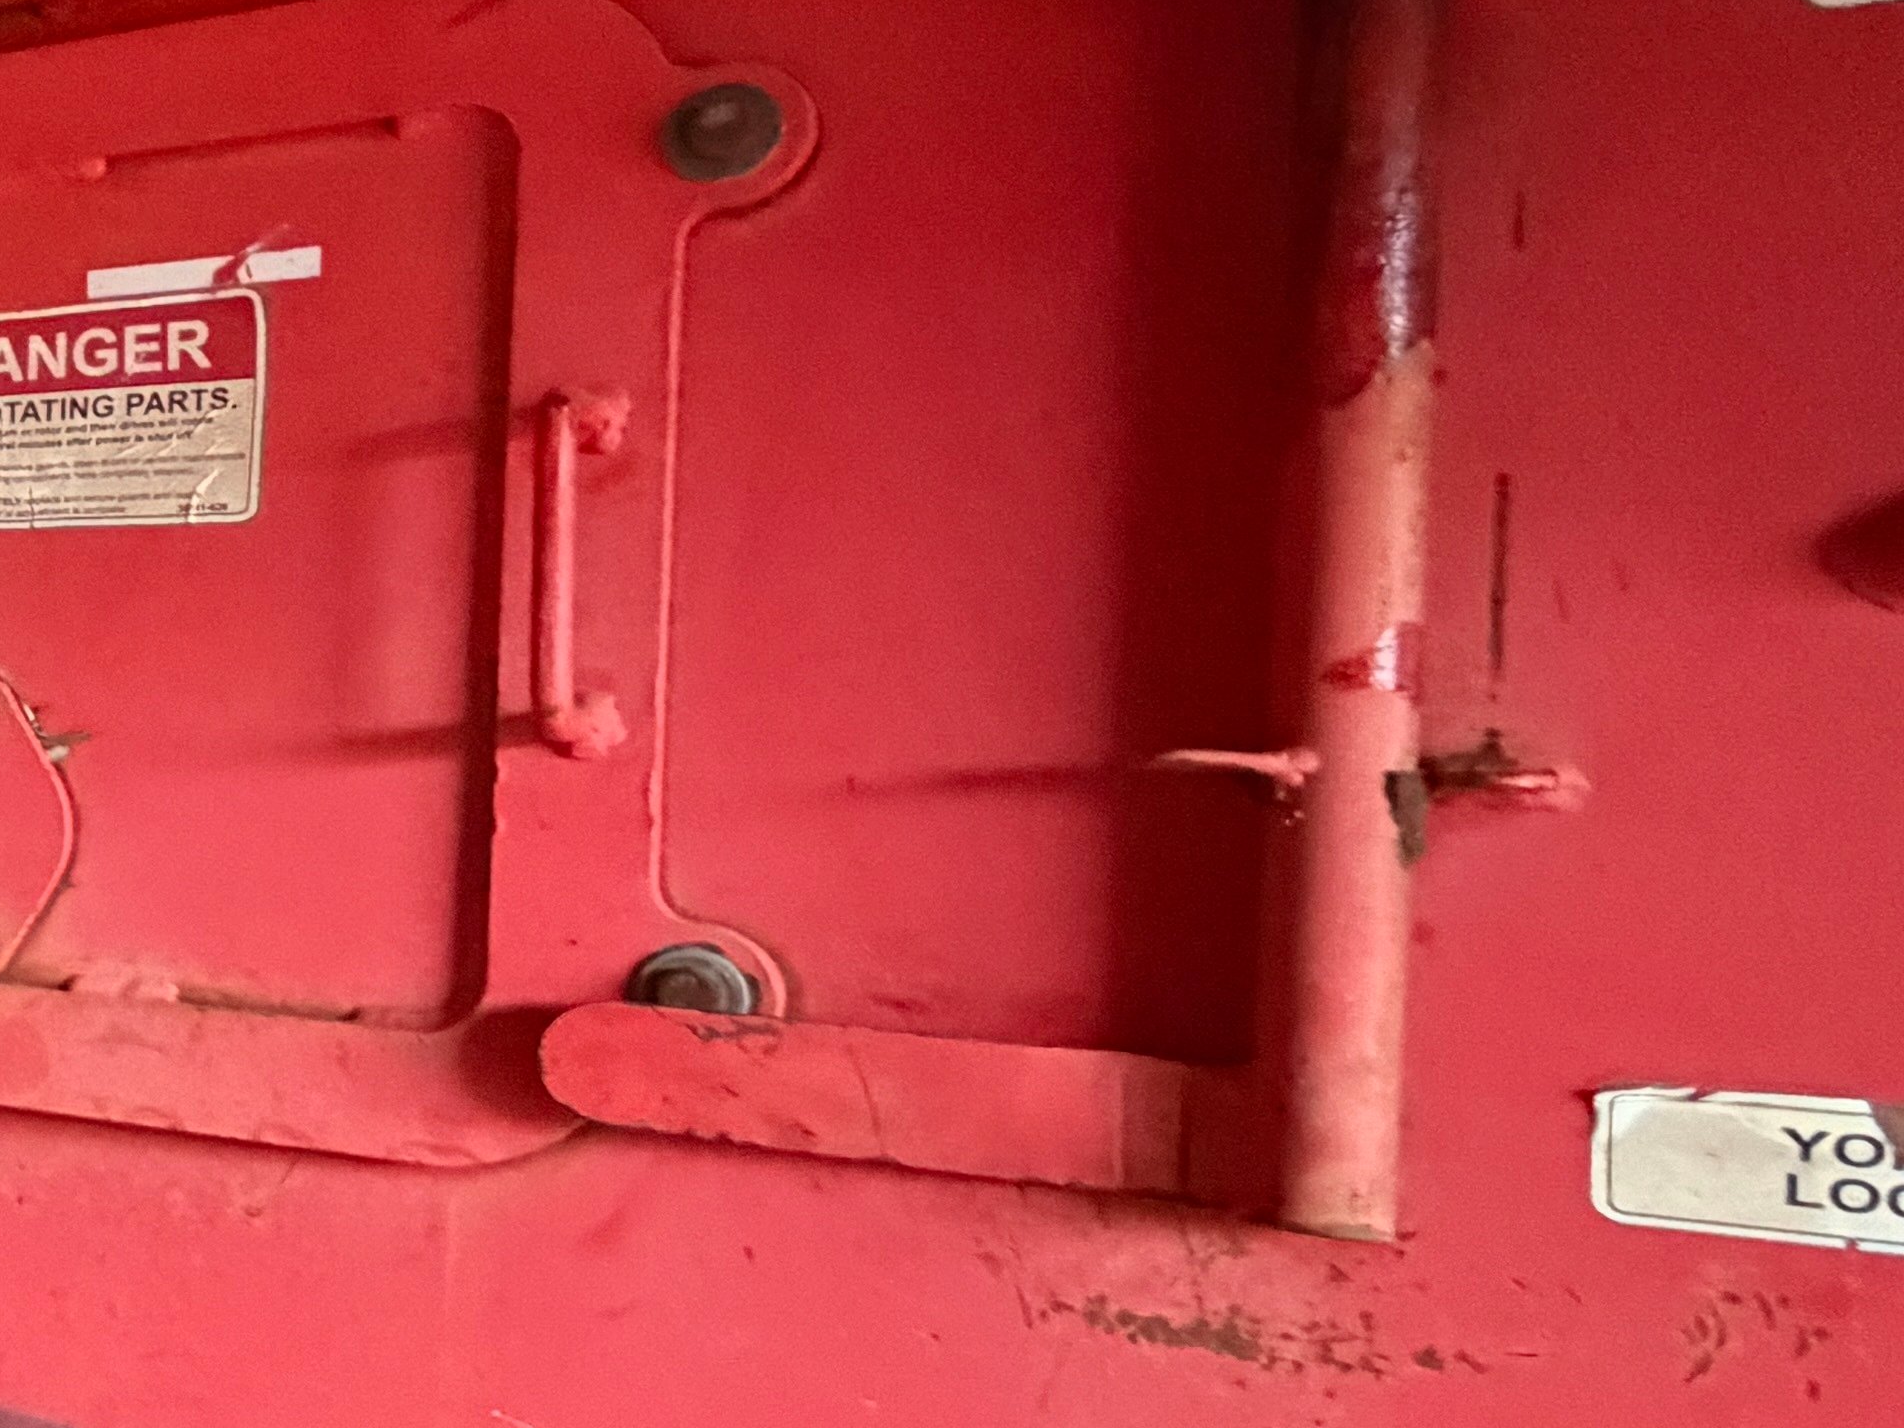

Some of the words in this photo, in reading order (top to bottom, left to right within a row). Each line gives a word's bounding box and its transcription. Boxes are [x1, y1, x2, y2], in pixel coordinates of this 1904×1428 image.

[125, 387, 239, 416] PARTS.
[65, 424, 88, 433] and
[66, 437, 92, 447] after
[95, 436, 131, 445] power
